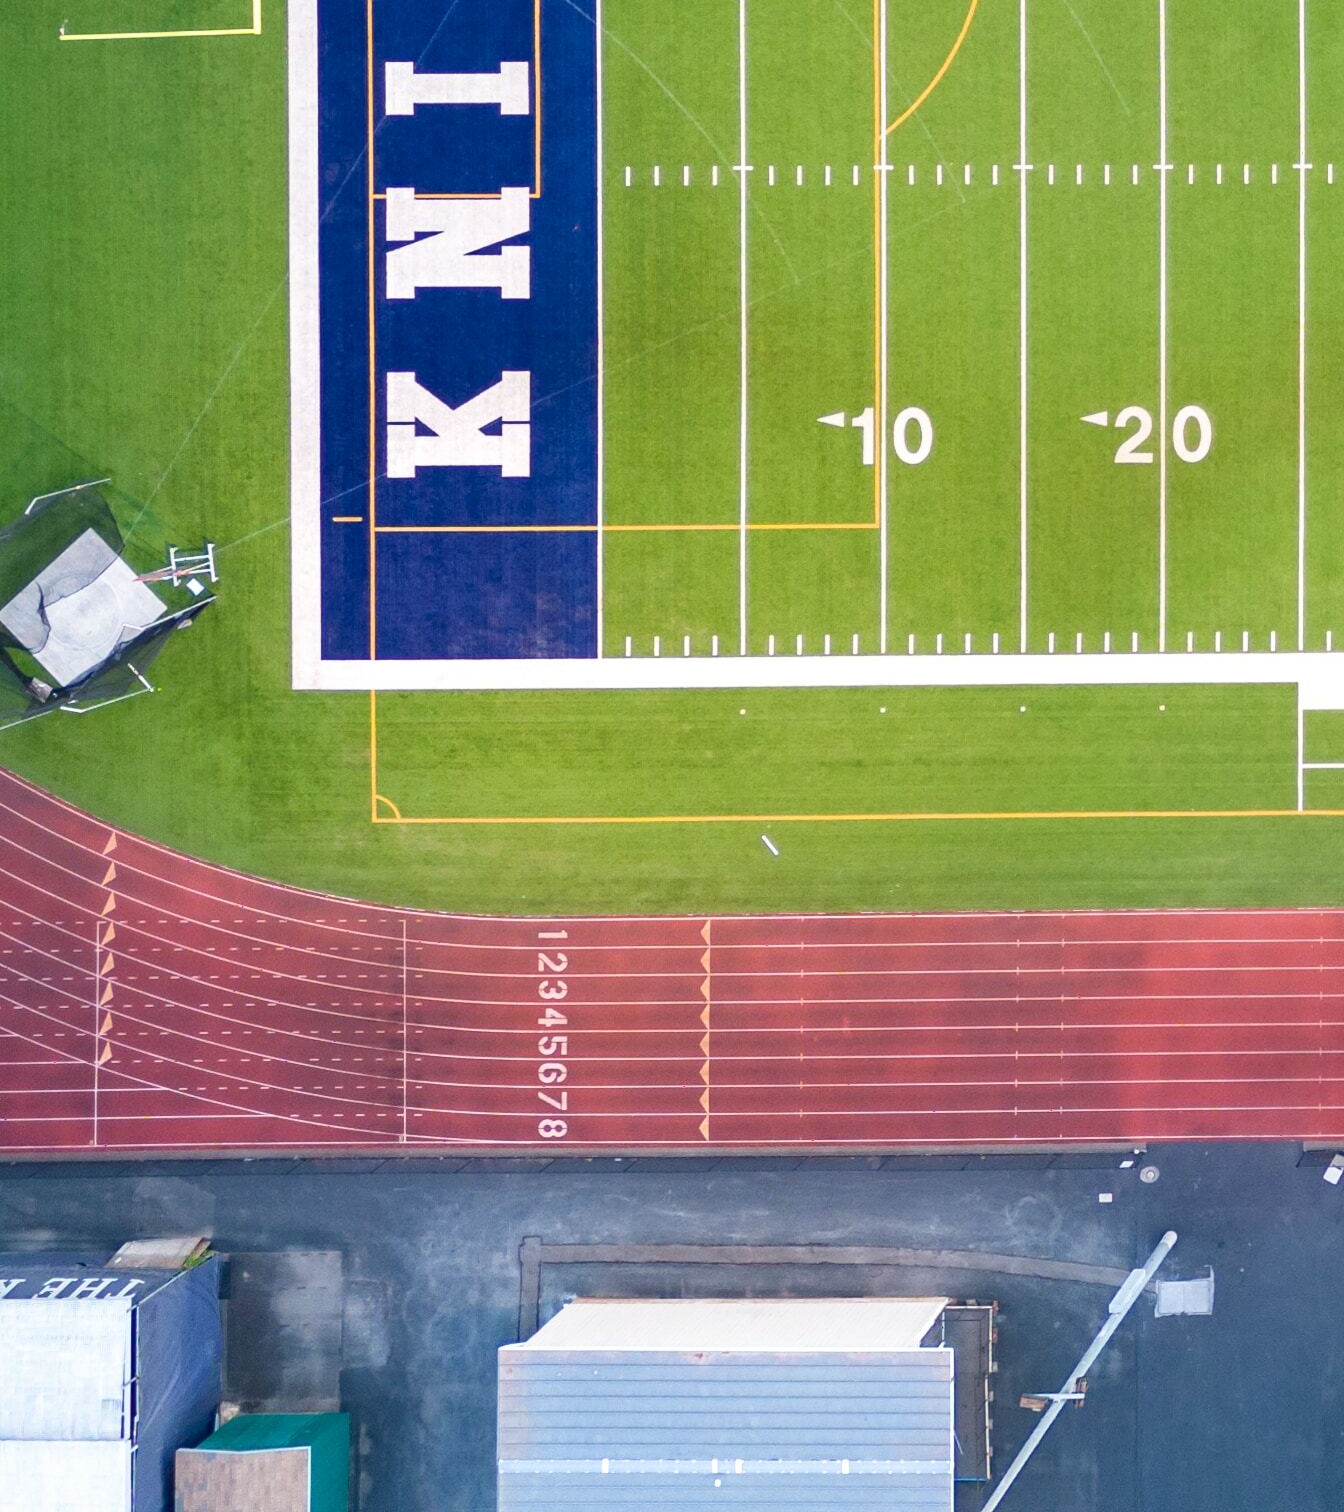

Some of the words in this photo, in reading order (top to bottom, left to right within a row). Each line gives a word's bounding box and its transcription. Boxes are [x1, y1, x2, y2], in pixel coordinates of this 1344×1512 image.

[851, 406, 933, 465] 10
[1113, 405, 1213, 463] 20
[538, 929, 568, 939] 1
[538, 952, 568, 972] 2
[538, 980, 568, 1000] 3
[538, 1008, 568, 1028] 4
[538, 1036, 568, 1056] 5
[538, 1063, 568, 1084] 6
[538, 1091, 568, 1111] 7
[538, 1118, 568, 1138] 8
[32, 1277, 146, 1300] THE
